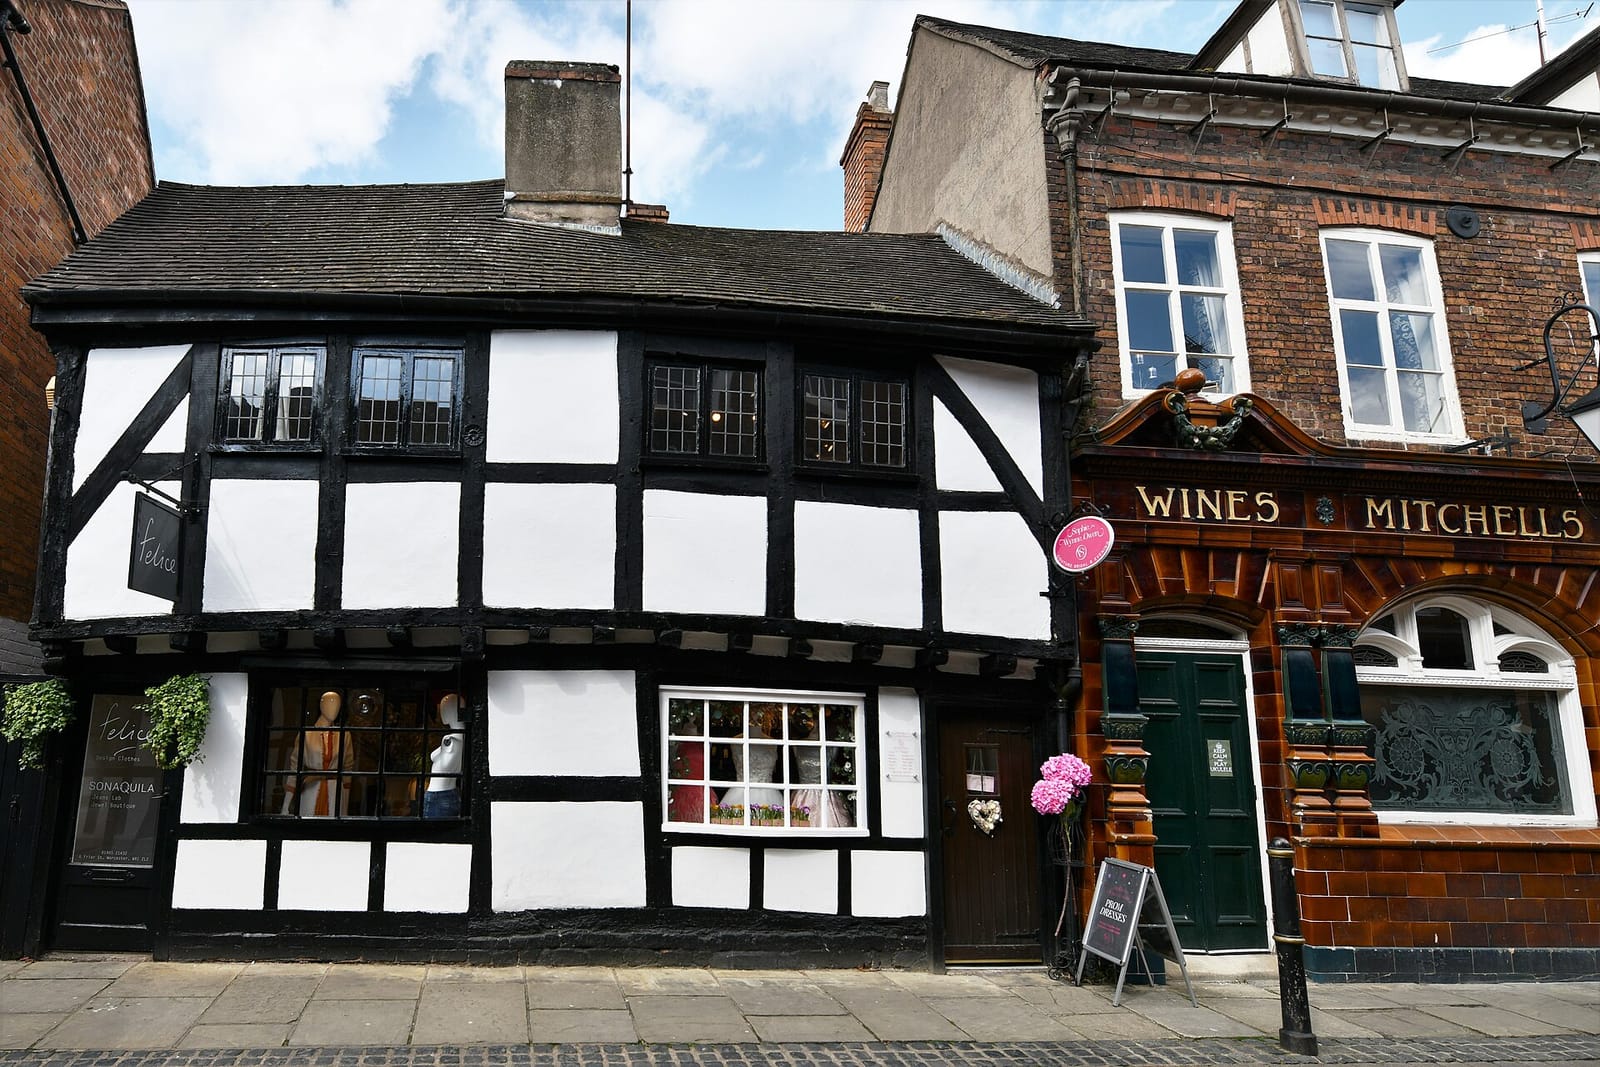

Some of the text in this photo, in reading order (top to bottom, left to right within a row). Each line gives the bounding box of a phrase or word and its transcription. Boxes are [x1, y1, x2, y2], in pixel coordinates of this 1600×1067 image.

[1135, 486, 1280, 523] WINES
[1365, 497, 1584, 539] MITCHELLS
[1068, 523, 1095, 537] Sophie
[88, 781, 155, 794] SONAQUILA
[1104, 898, 1124, 913] PROM
[1099, 906, 1128, 924] DRESSES
